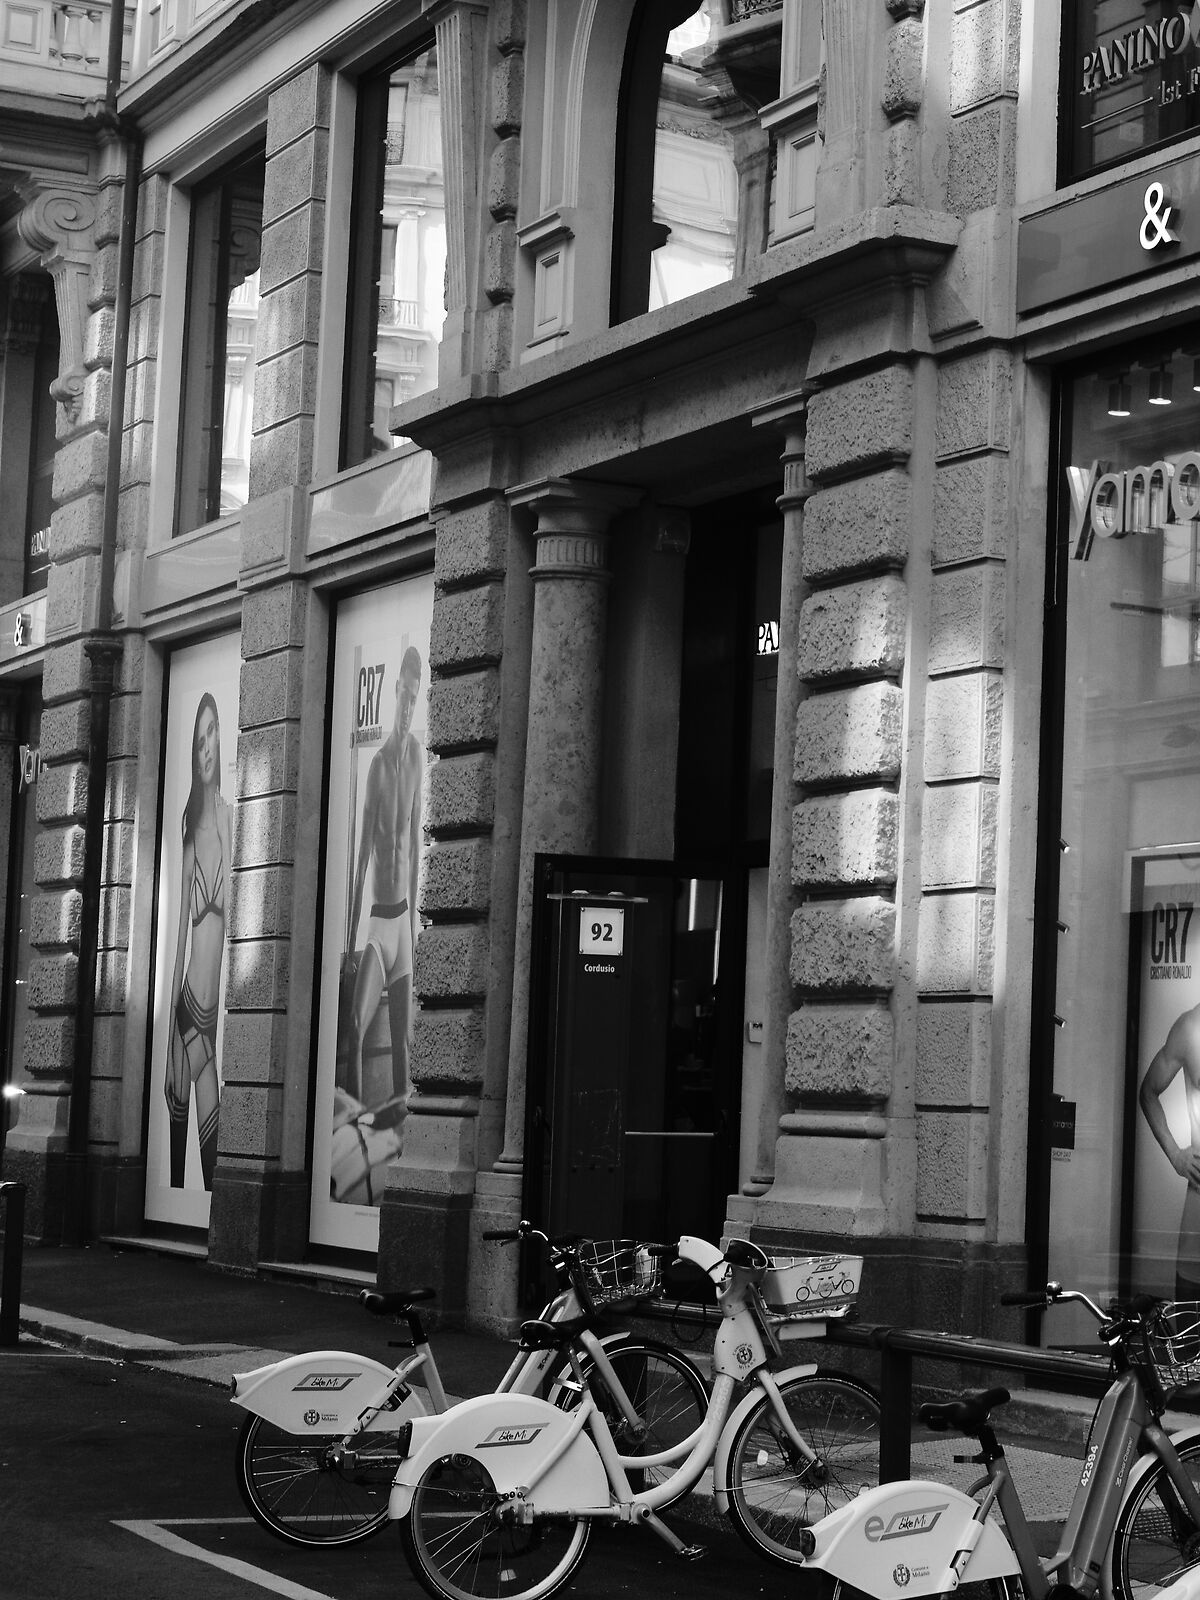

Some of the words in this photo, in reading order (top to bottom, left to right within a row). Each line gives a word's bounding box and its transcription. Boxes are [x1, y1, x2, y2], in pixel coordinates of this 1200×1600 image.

[1079, 11, 1190, 95] PANINO
[1140, 181, 1173, 250] &
[357, 663, 386, 728] CR7
[591, 922, 613, 942] 92
[1151, 901, 1194, 964] CR7
[584, 963, 615, 973] Cordusio
[1081, 1444, 1099, 1487] 42394
